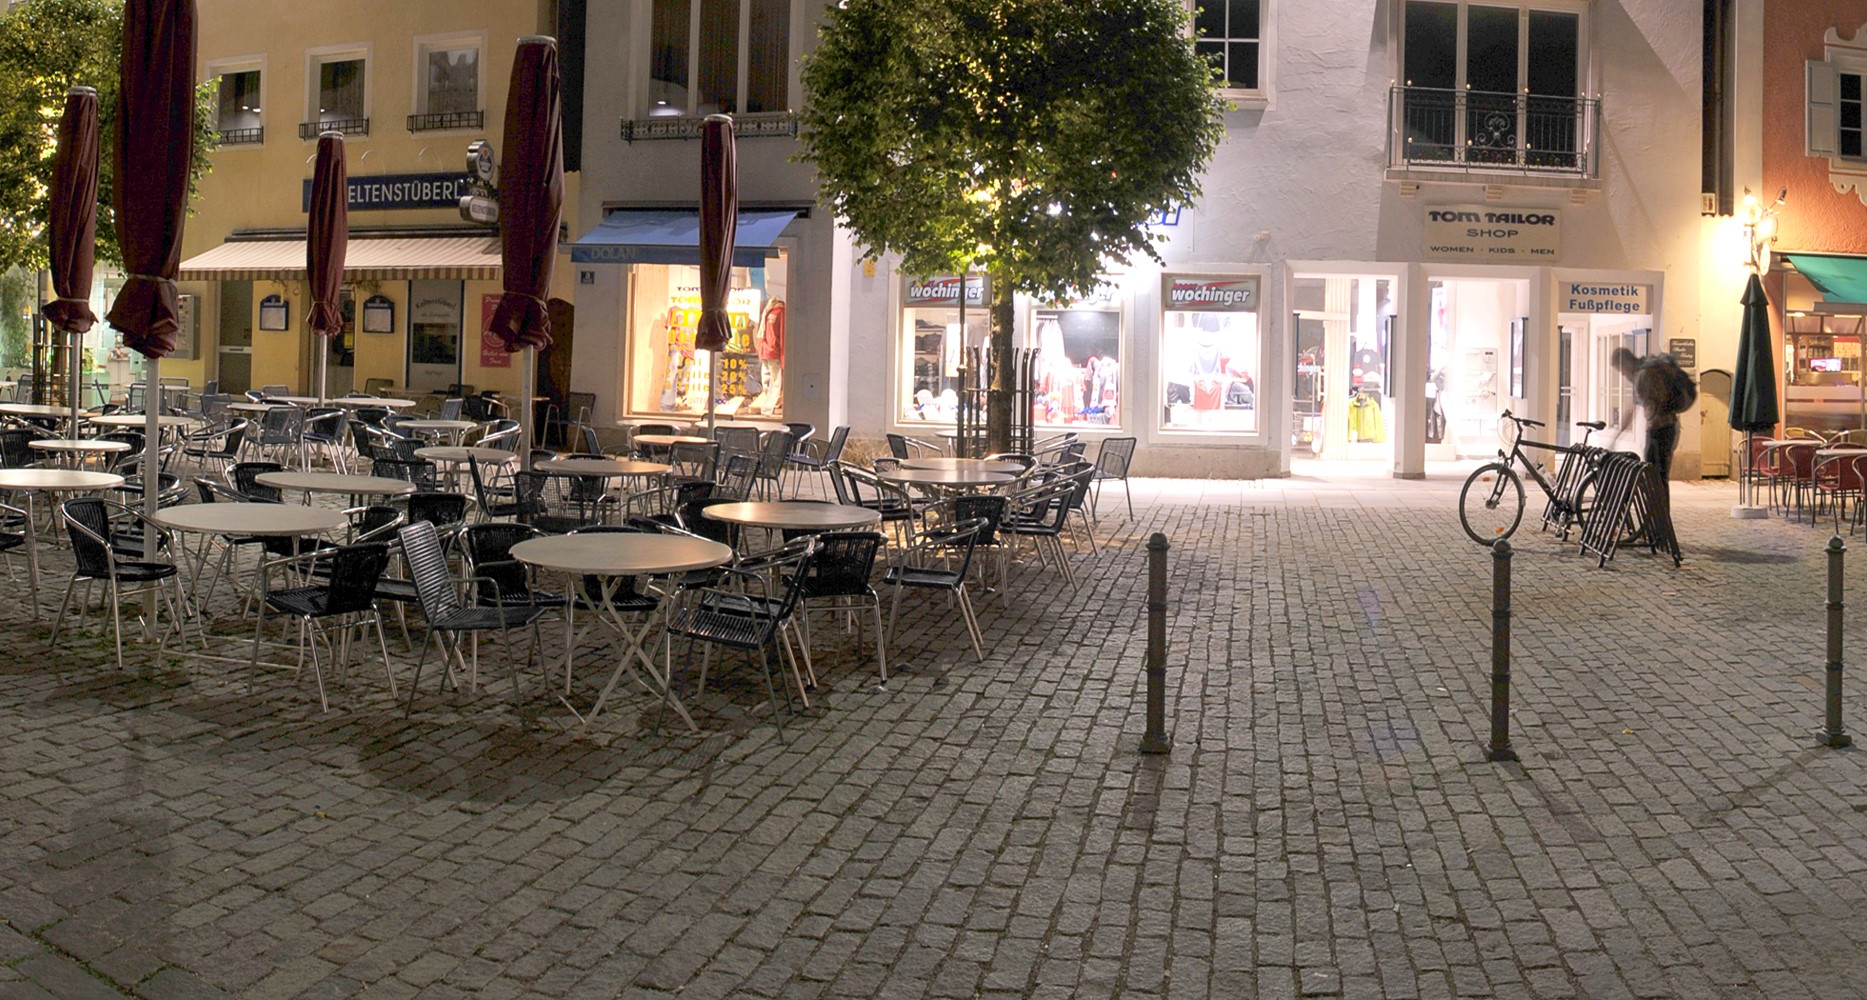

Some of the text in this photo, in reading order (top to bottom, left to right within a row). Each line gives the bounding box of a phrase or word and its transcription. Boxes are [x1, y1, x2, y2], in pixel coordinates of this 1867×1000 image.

[348, 180, 462, 203] ELTENSTÜBERL
[1429, 210, 1555, 226] TOM TAILOR
[1466, 228, 1519, 238] SHOP
[1430, 245, 1474, 253] WOMEN
[1171, 286, 1250, 306] wochinger
[1571, 284, 1639, 297] Kosmetik
[1569, 299, 1640, 313] Fußpflege
